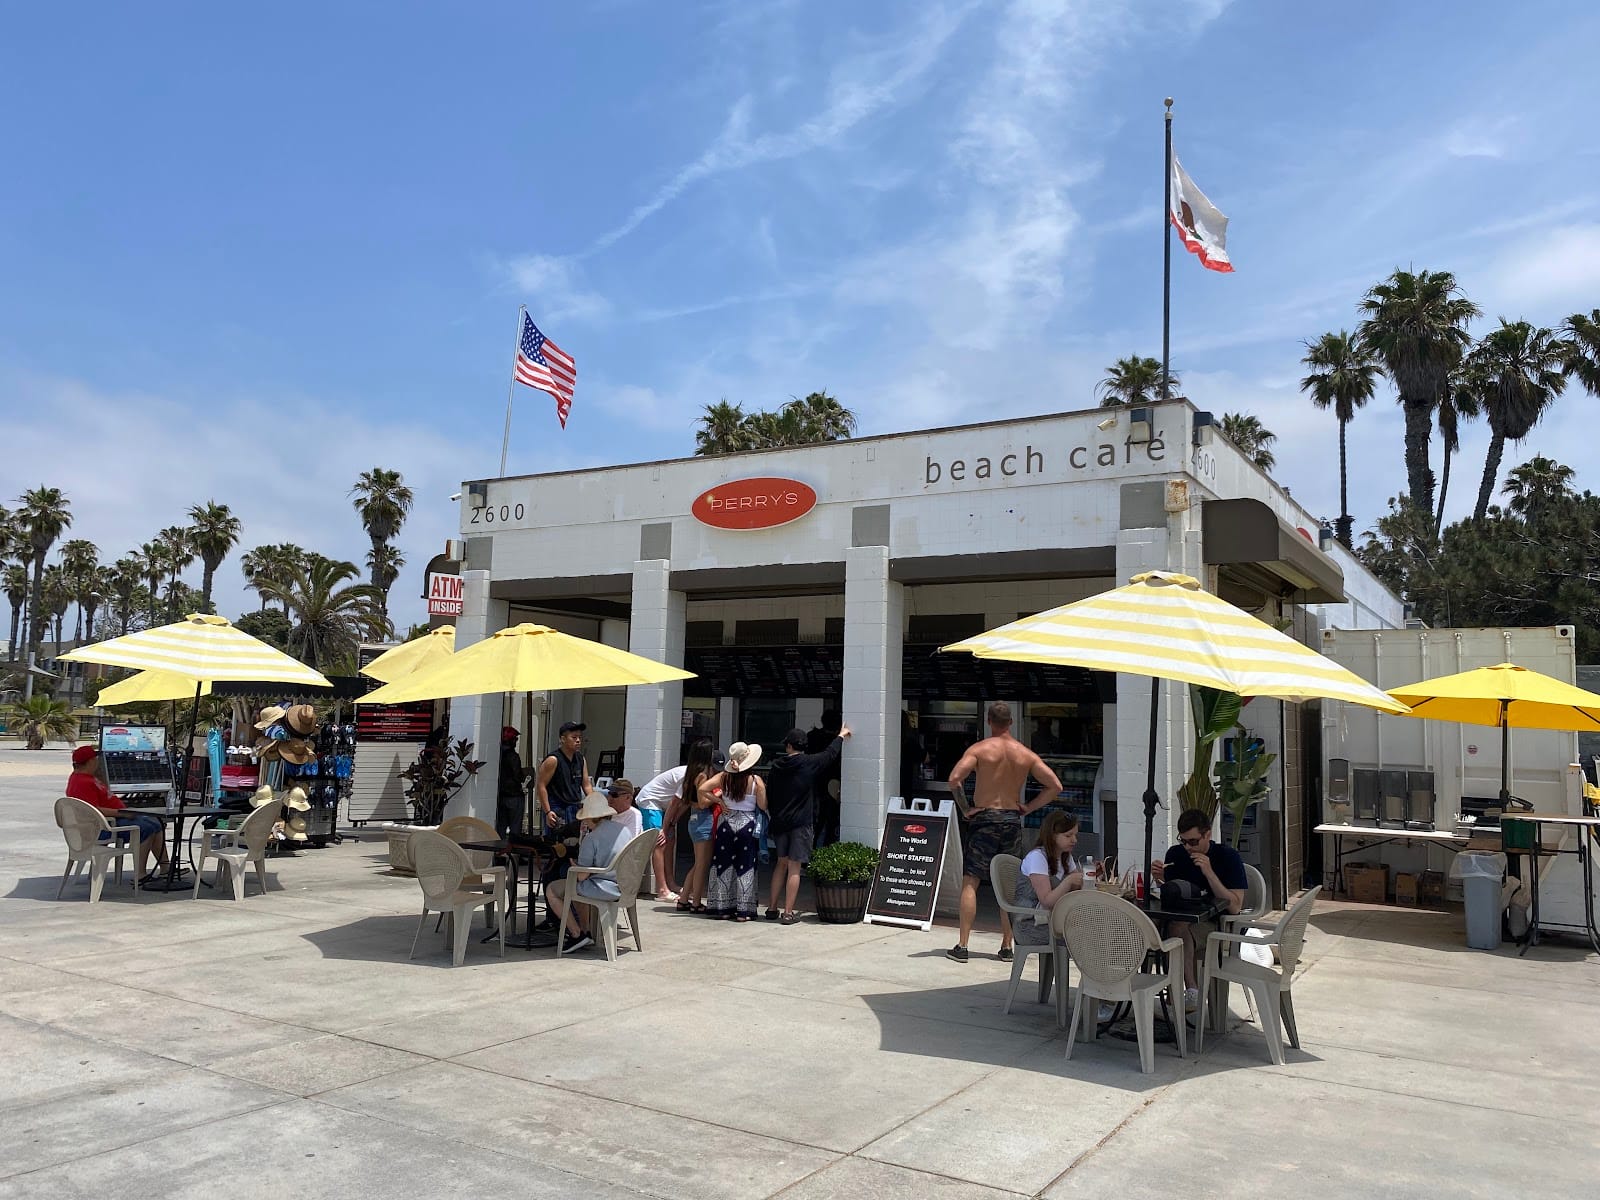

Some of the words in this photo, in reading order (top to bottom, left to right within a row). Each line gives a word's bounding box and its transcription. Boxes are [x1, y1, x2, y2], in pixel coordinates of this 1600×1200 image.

[926, 445, 1043, 484] beach
[1069, 430, 1165, 469] café
[711, 490, 798, 511] PERRY'S
[470, 503, 524, 524] 2600
[431, 575, 463, 598] ATM
[430, 600, 462, 613] INSIDE
